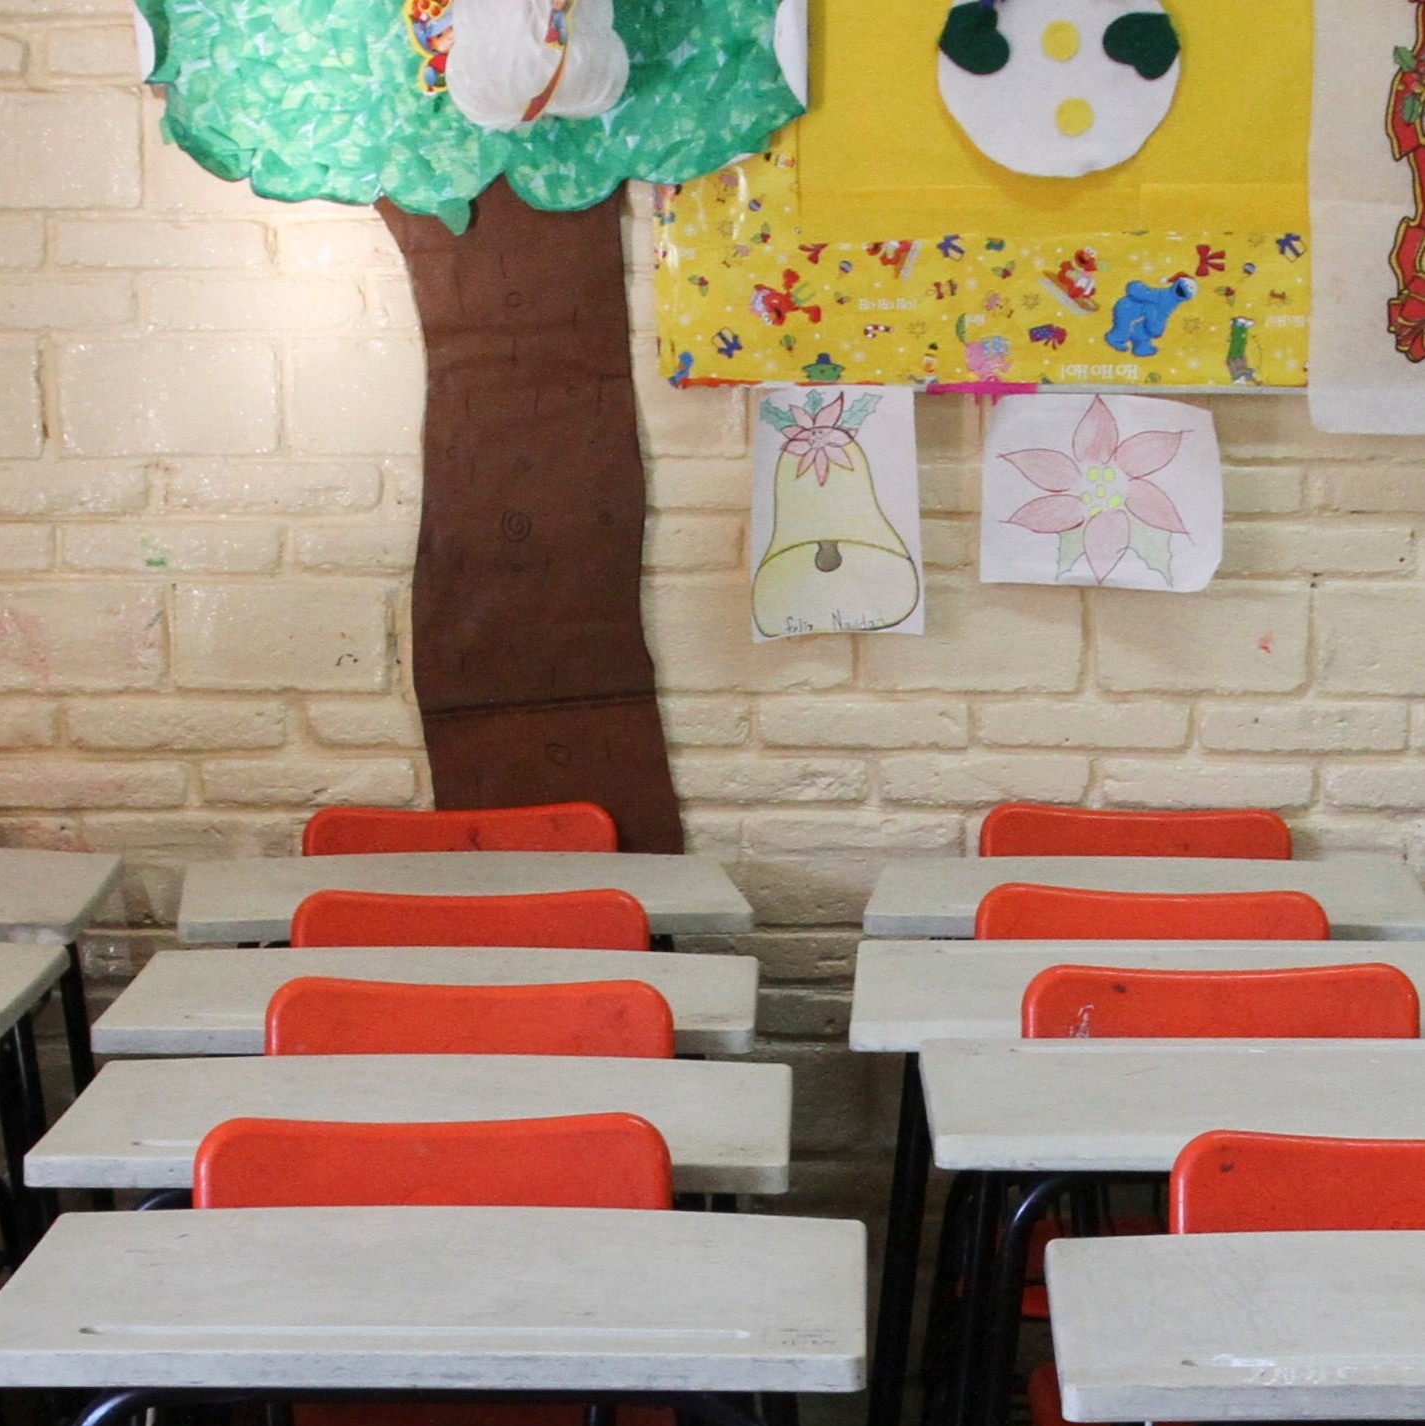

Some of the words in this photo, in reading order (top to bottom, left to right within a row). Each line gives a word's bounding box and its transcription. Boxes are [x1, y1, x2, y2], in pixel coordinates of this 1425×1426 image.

[1060, 364, 1088, 380] Ho!
[1091, 364, 1113, 379] Ho
[1116, 364, 1139, 380] Ho
